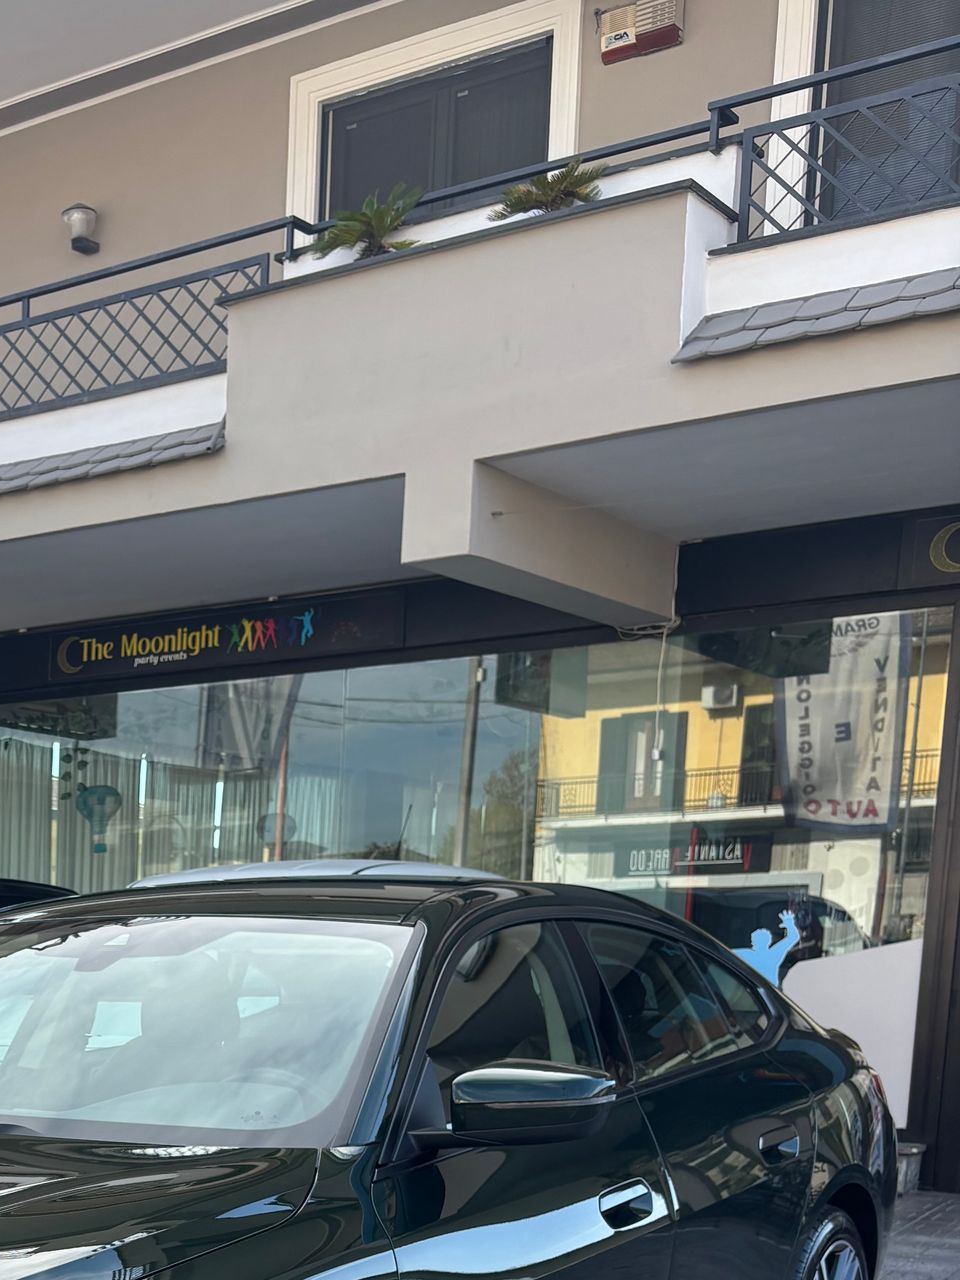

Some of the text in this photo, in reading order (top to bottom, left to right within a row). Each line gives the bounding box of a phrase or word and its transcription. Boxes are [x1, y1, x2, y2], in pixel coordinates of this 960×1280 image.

[79, 625, 220, 663] The Moonlight
[133, 651, 188, 668] party events
